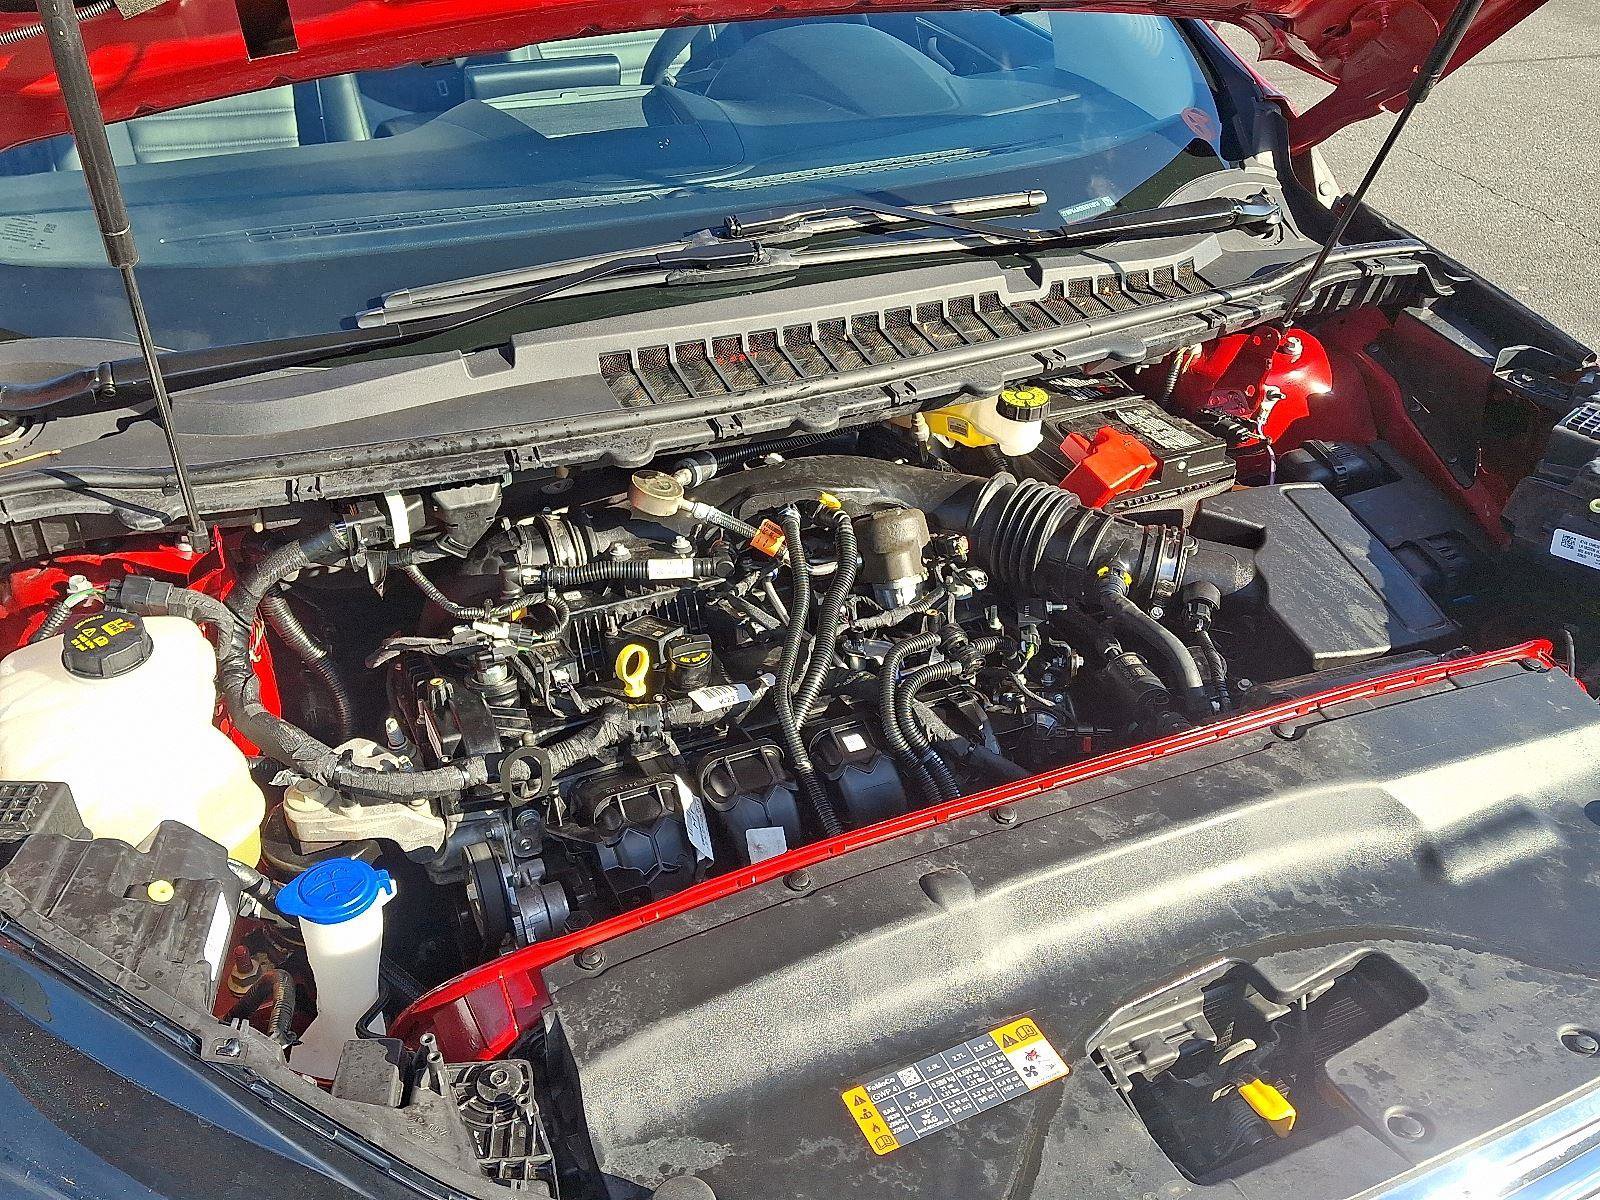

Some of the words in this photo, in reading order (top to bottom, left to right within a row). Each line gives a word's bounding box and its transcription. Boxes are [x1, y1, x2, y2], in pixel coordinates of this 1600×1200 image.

[974, 1043, 988, 1052] 2.0L
[952, 1052, 967, 1062] 2.7L
[926, 1062, 942, 1072] 2.0L
[946, 1075, 956, 1083] kg
[866, 1078, 895, 1092] FoMoCo
[871, 1089, 893, 1102] (GWP
[922, 1116, 939, 1126] PAG
